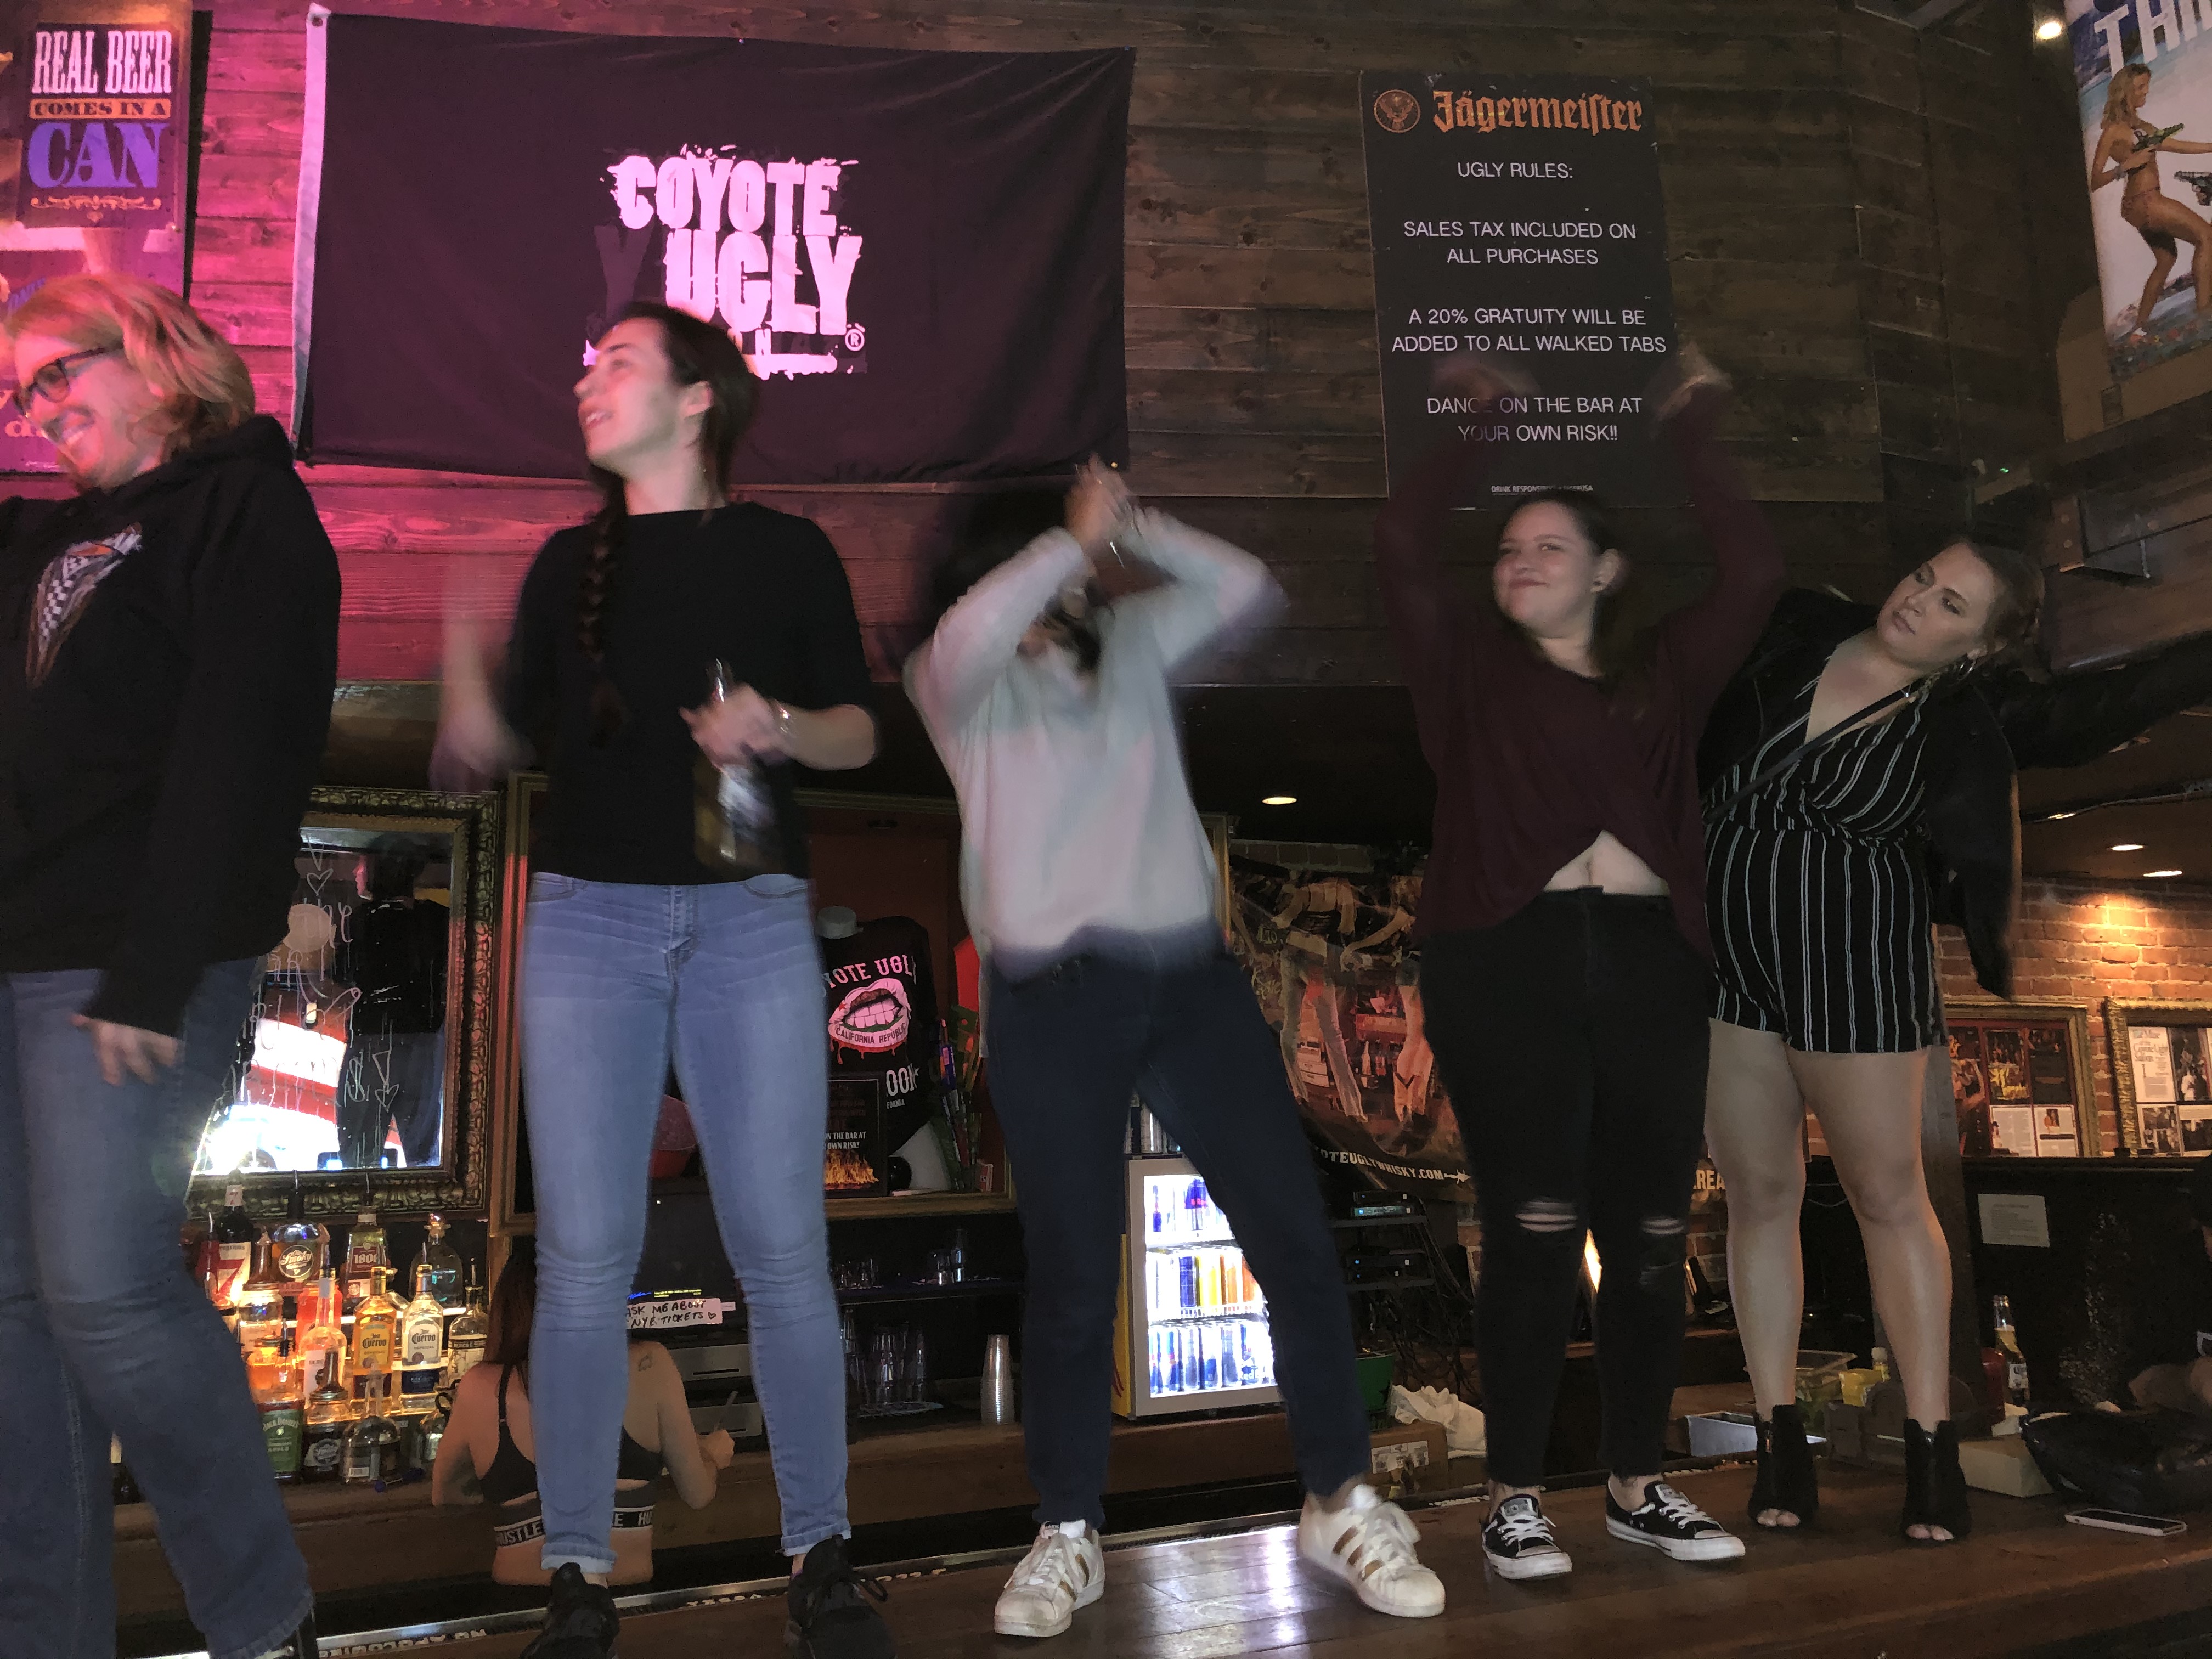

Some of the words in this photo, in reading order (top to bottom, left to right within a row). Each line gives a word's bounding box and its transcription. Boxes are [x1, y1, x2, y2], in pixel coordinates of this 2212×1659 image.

[32, 30, 99, 94] REAL
[105, 30, 171, 94] BEER
[34, 102, 112, 116] COMES
[120, 102, 144, 116] IN
[151, 102, 167, 116] A
[27, 122, 170, 189] CAN
[1457, 161, 1503, 179] UGLY
[1510, 161, 1573, 180] RULES:
[610, 154, 842, 236] COYOTE
[1403, 221, 1463, 238] SALES
[1469, 221, 1505, 238] TAX
[1510, 222, 1602, 239] INCLUDED
[1609, 223, 1637, 239] ON
[1447, 248, 1481, 264] ALL
[1486, 248, 1599, 265] PURCHASES
[665, 228, 862, 335] UGLY
[1408, 308, 1423, 325] A
[1427, 308, 1469, 325] 20%
[1474, 308, 1567, 325] GRATUITY
[1571, 308, 1616, 326] WILL
[1622, 308, 1646, 326] BE
[1392, 334, 1458, 352] ADDED
[1464, 335, 1490, 352] TO
[1496, 335, 1531, 352] ALL
[1535, 335, 1613, 353] WALKED
[1619, 335, 1667, 354] TABS
[1499, 397, 1528, 414] ON
[1534, 397, 1571, 413] THE
[1577, 397, 1614, 413] BAR
[1620, 397, 1643, 413] AT
[1458, 425, 1510, 442] YOUR
[1516, 425, 1561, 442] OWN
[1567, 425, 1618, 442] RISK!!
[836, 1027, 875, 1043] CALIFORNIA
[879, 1022, 907, 1043] REPUBLIC
[832, 1132, 844, 1140] THE
[858, 1131, 867, 1139] AT
[652, 1302, 669, 1314] ME
[672, 1300, 707, 1312] ABOUT
[630, 1316, 657, 1329] NYE
[661, 1311, 704, 1325] TICKETS
[362, 1337, 387, 1349] Cuervo
[411, 1333, 436, 1344] Cuervo
